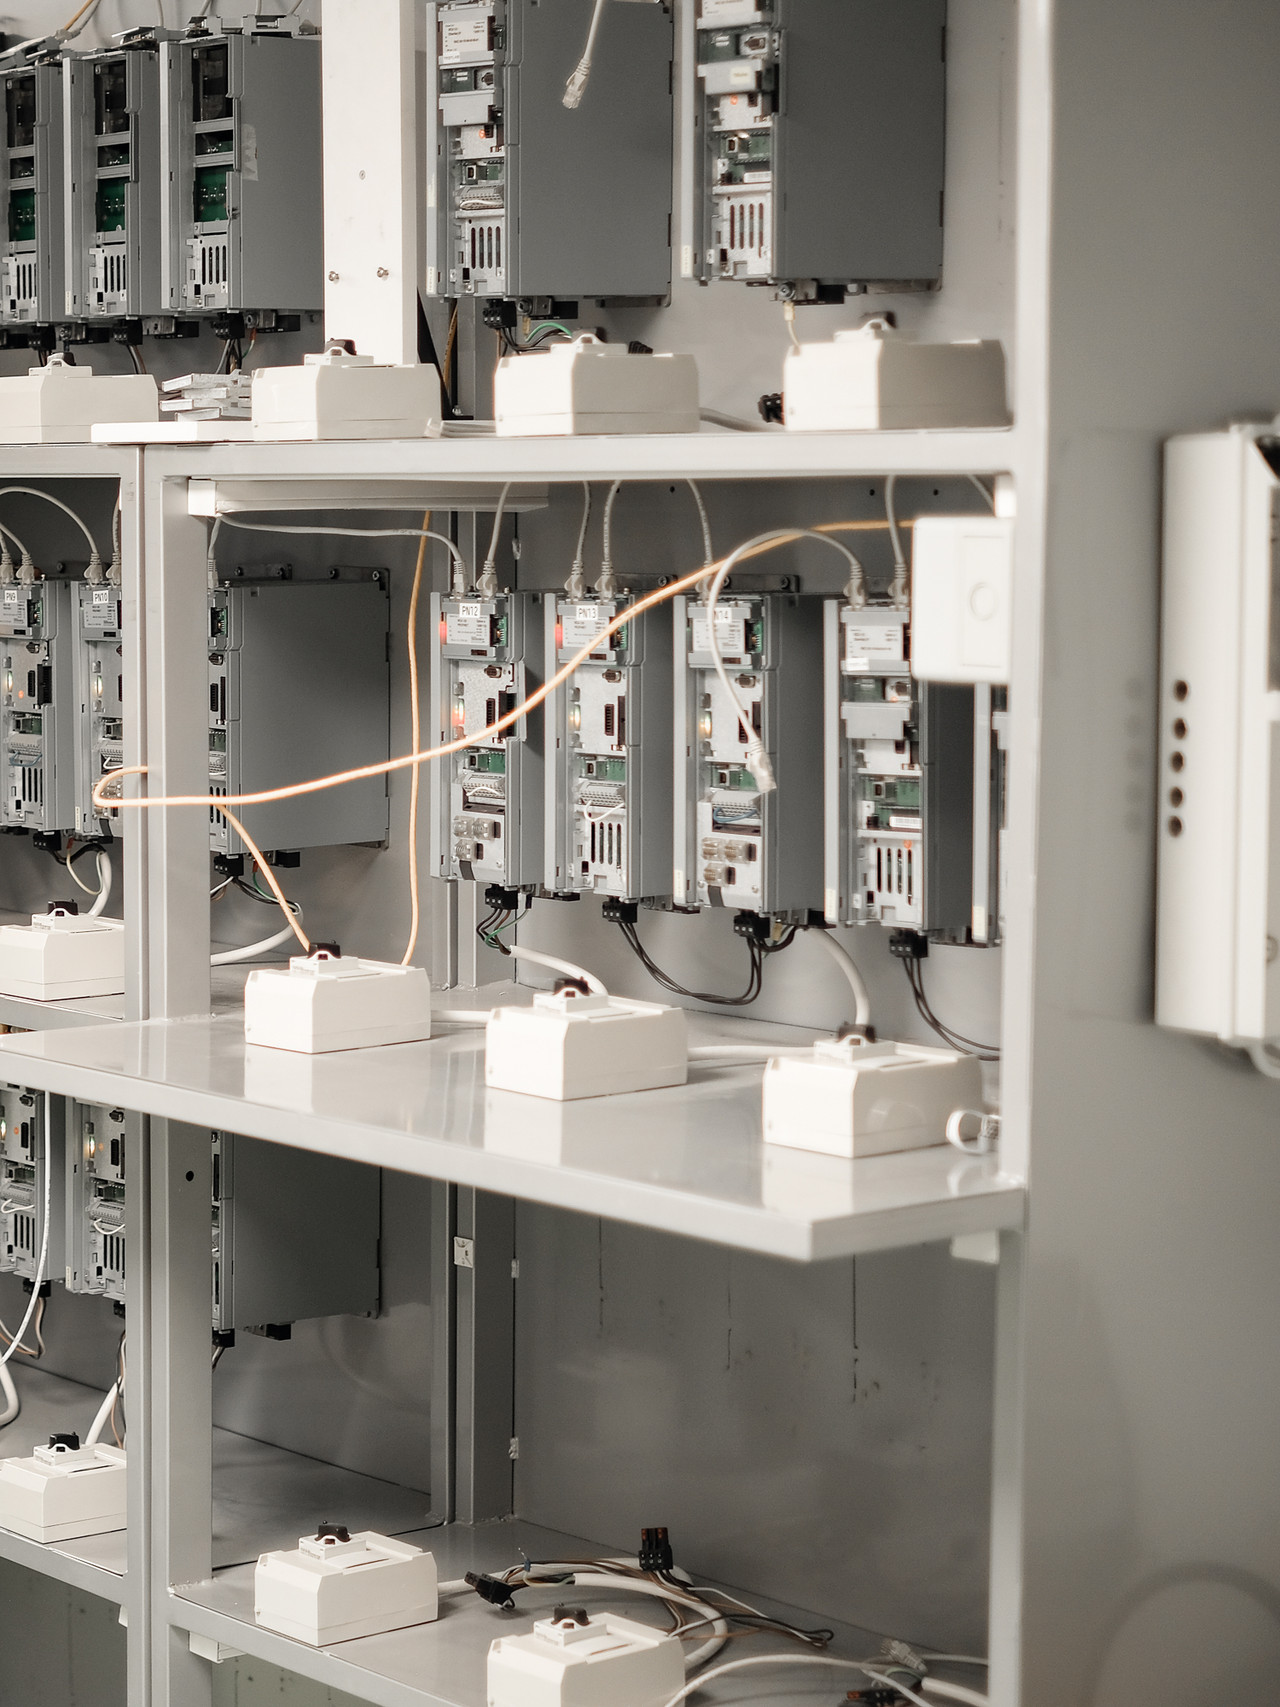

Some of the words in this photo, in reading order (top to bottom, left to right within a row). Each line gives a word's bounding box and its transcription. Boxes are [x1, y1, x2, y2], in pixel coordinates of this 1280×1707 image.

[6, 592, 16, 601] PN9
[94, 592, 108, 603] PN10
[461, 605, 478, 616] PN12
[578, 608, 596, 619] PN13
